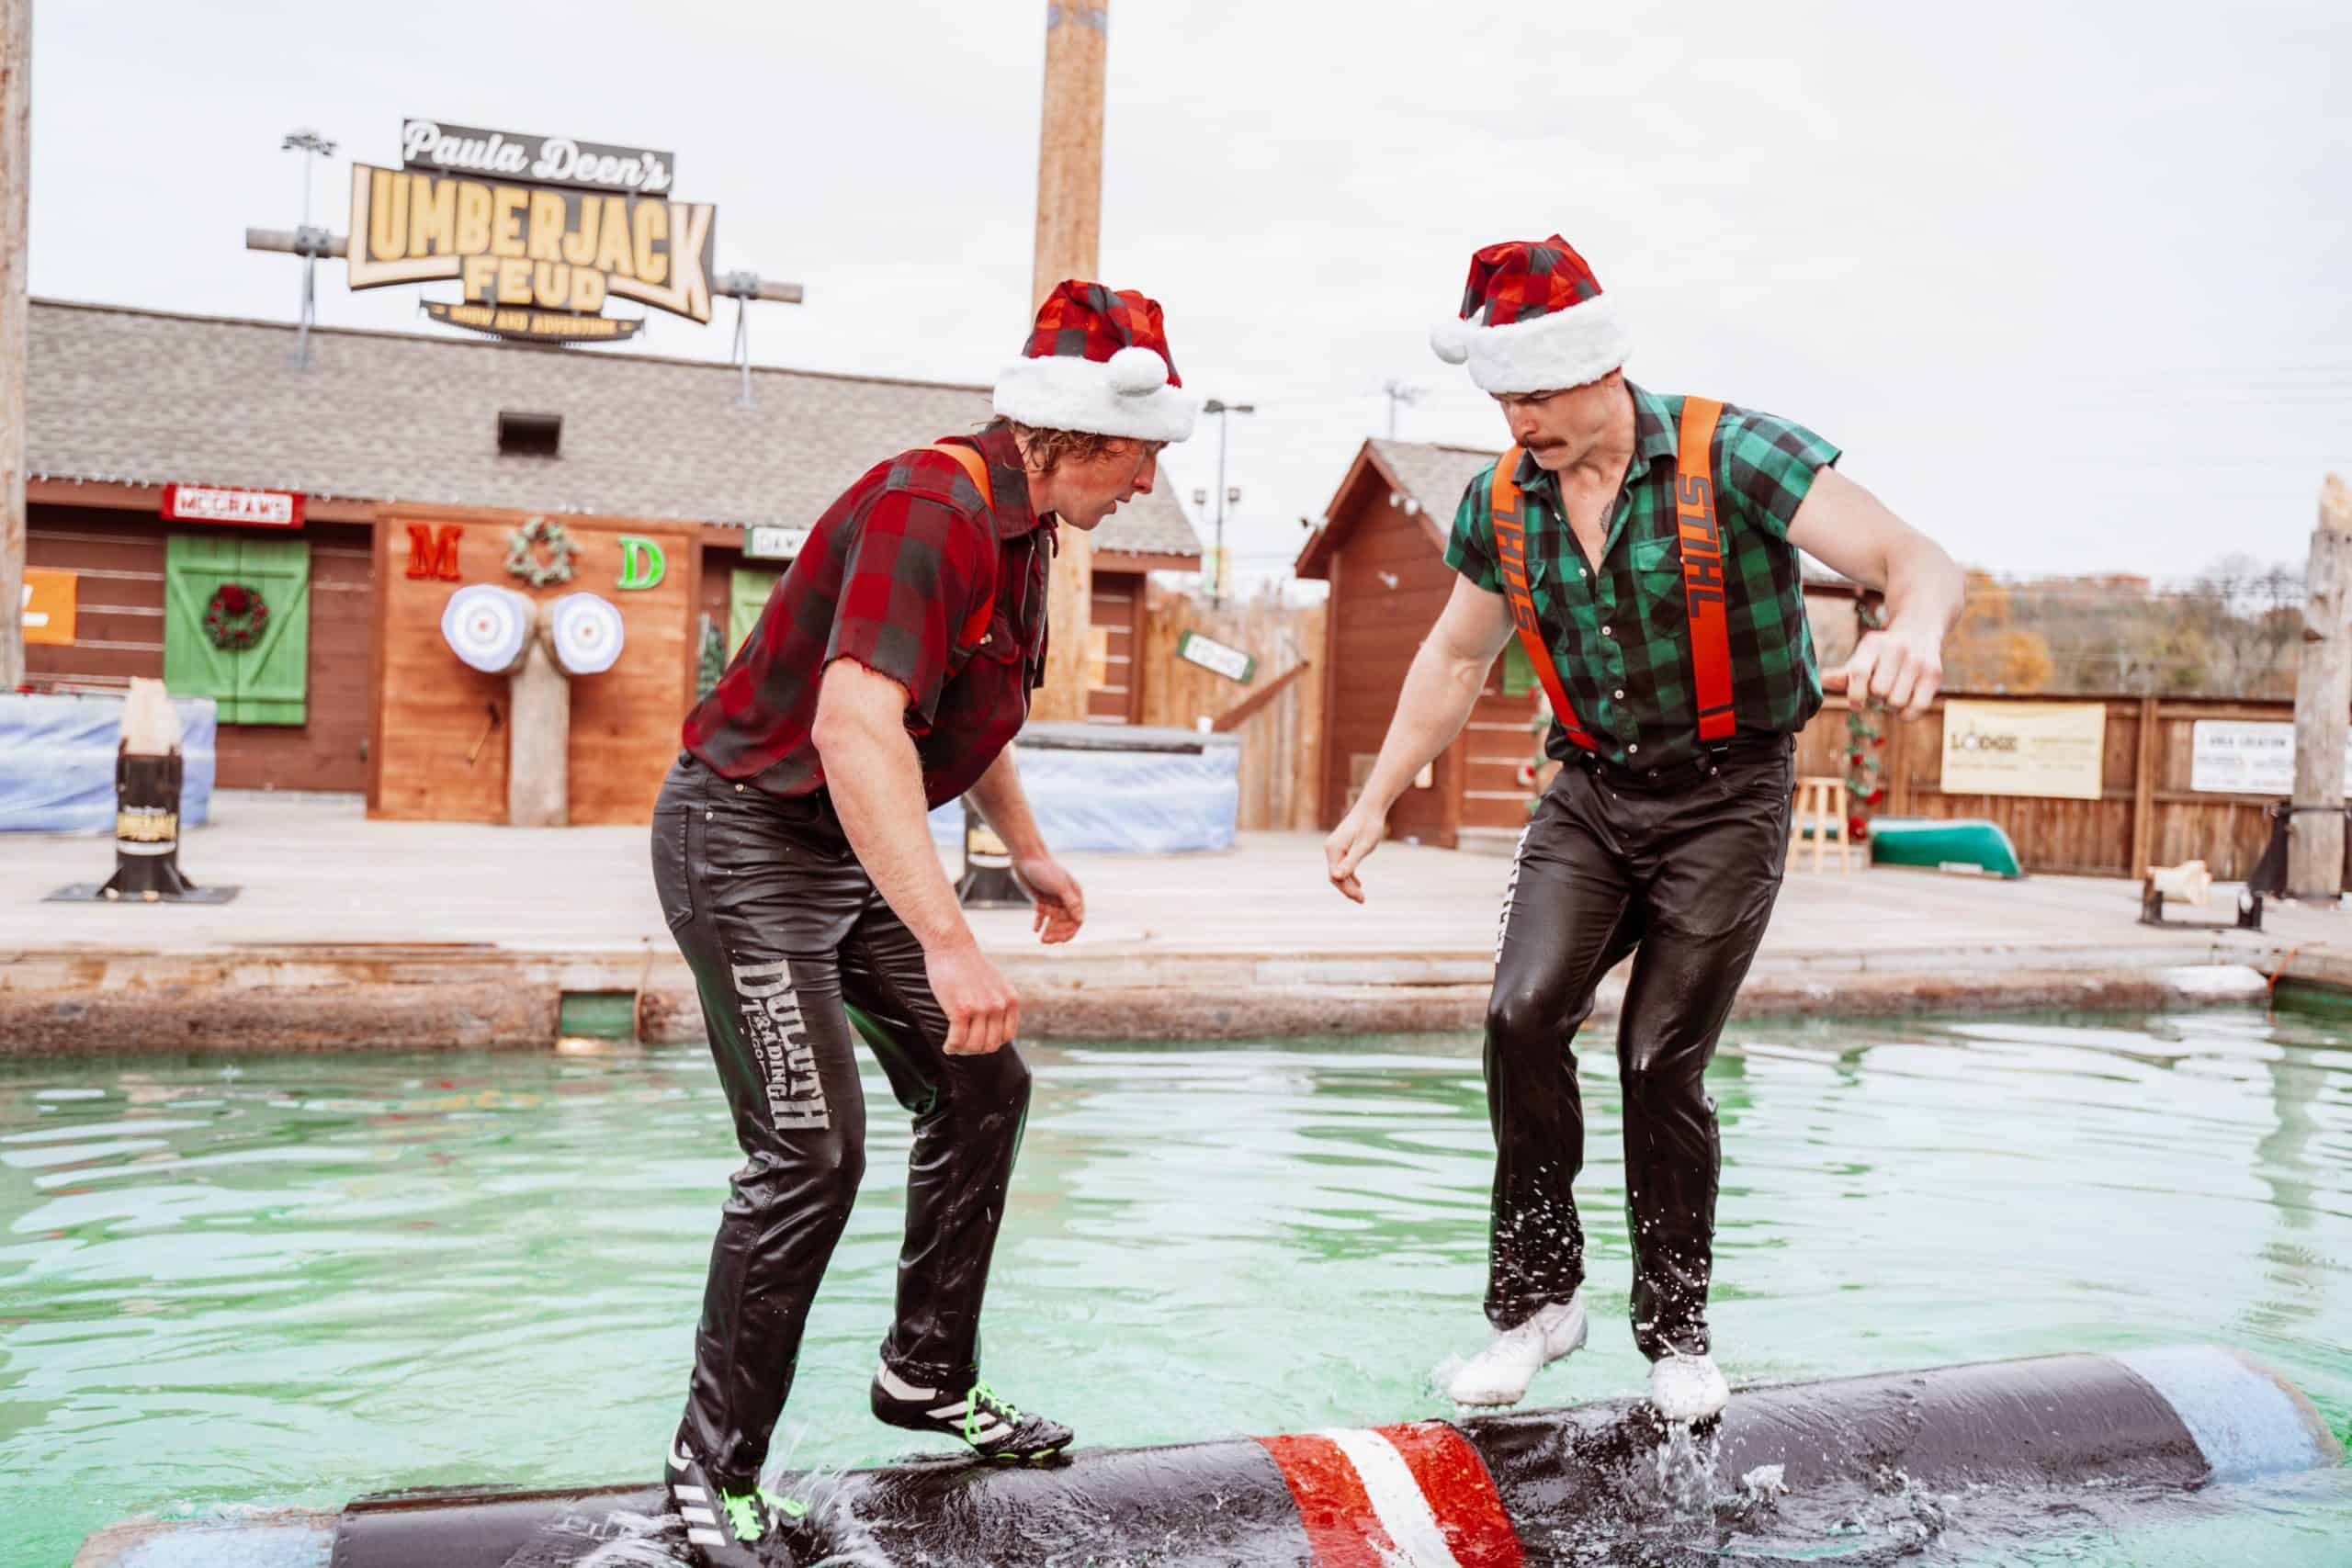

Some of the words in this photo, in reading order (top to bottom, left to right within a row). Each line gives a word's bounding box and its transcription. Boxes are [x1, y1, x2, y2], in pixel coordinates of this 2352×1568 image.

[403, 120, 529, 173] Paula
[532, 138, 672, 191] Deen's
[348, 162, 714, 324] LUMBERJACK
[464, 255, 606, 311] FEUD
[406, 523, 464, 581] M
[616, 536, 666, 591] D
[1494, 493, 1539, 637] STIHL
[1677, 473, 1724, 618] STIHL
[731, 959, 831, 1131] DULUTH
[741, 998, 787, 1100] TRADING
